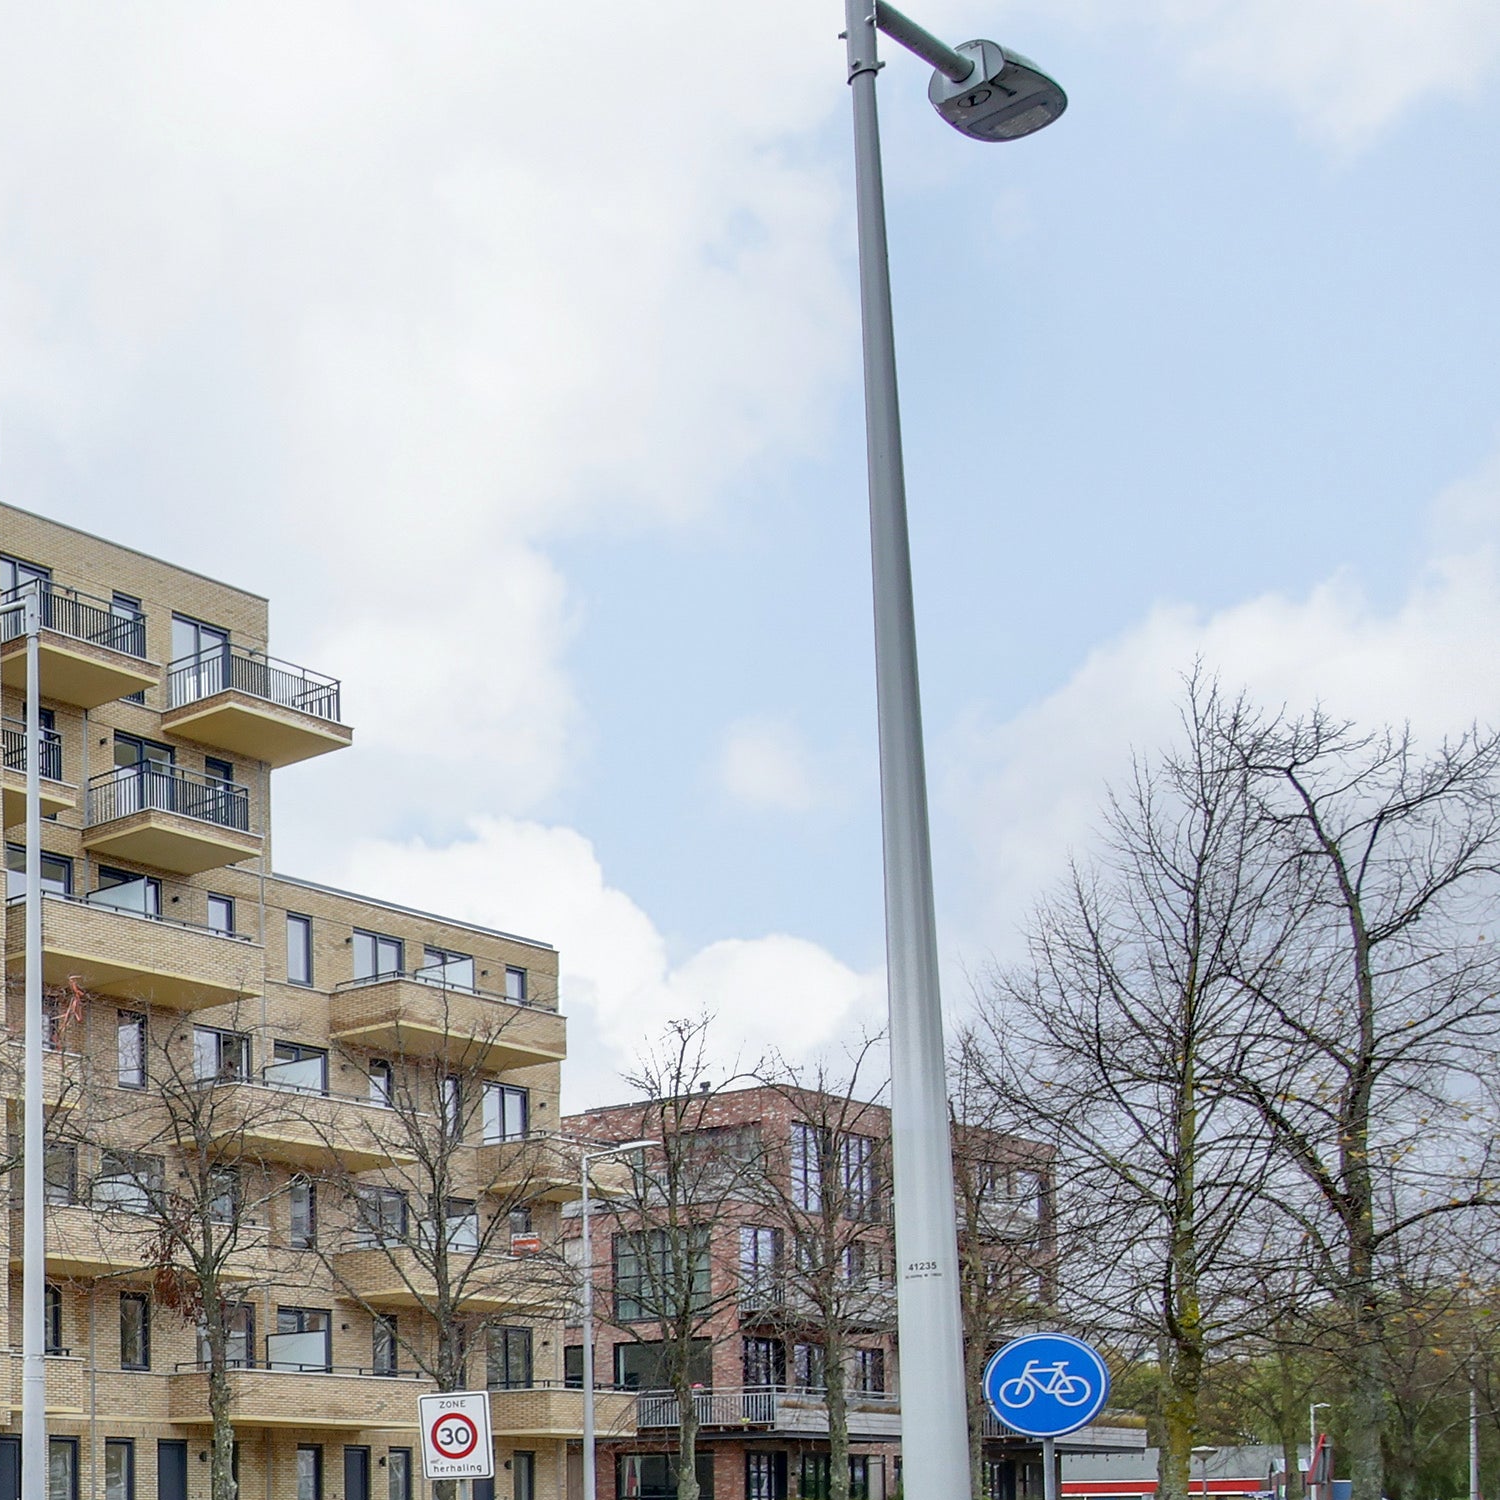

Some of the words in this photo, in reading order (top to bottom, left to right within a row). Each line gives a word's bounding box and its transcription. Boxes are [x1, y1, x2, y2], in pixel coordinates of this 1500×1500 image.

[908, 1261, 937, 1271] 41235
[439, 1400, 466, 1409] ZONE
[440, 1427, 470, 1446] 30
[433, 1464, 483, 1474] herhaling
